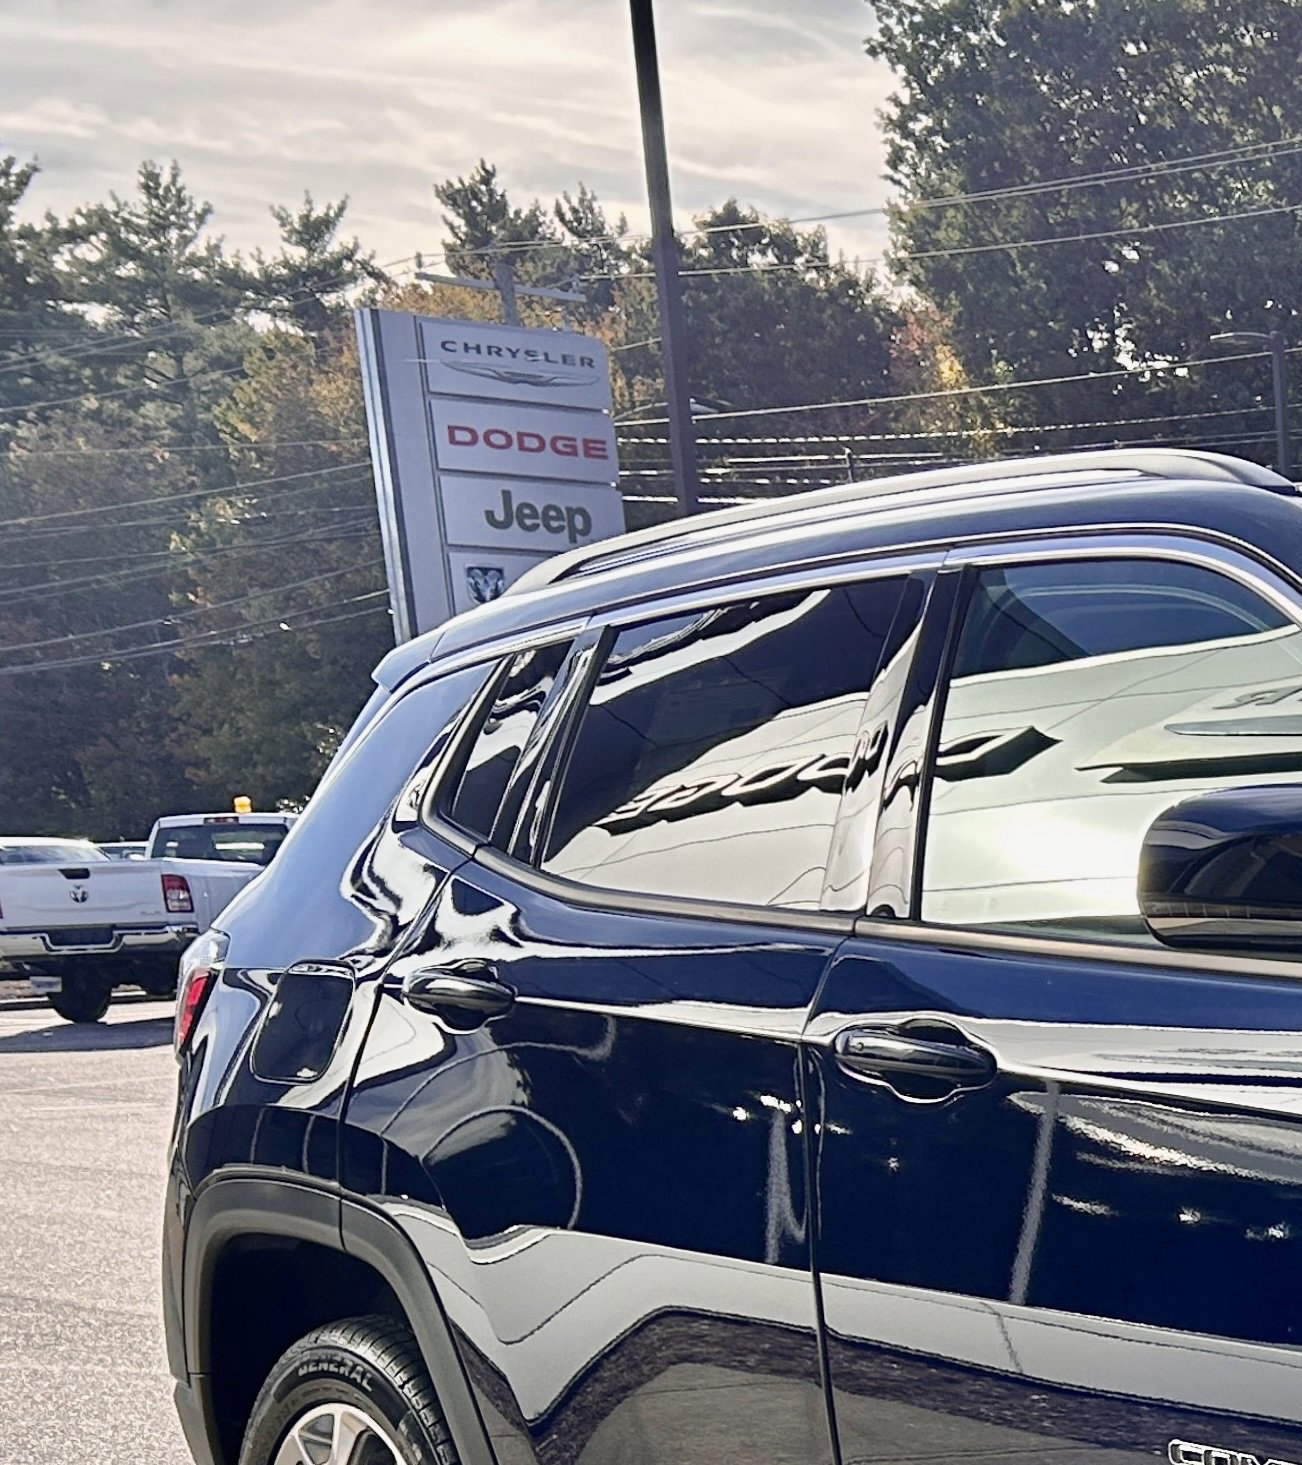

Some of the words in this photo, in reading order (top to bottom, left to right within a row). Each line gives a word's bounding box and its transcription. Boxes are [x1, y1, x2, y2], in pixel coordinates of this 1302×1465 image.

[440, 339, 595, 369] CHRYSLER
[447, 425, 609, 460] DODGE
[484, 489, 592, 543] Jeep
